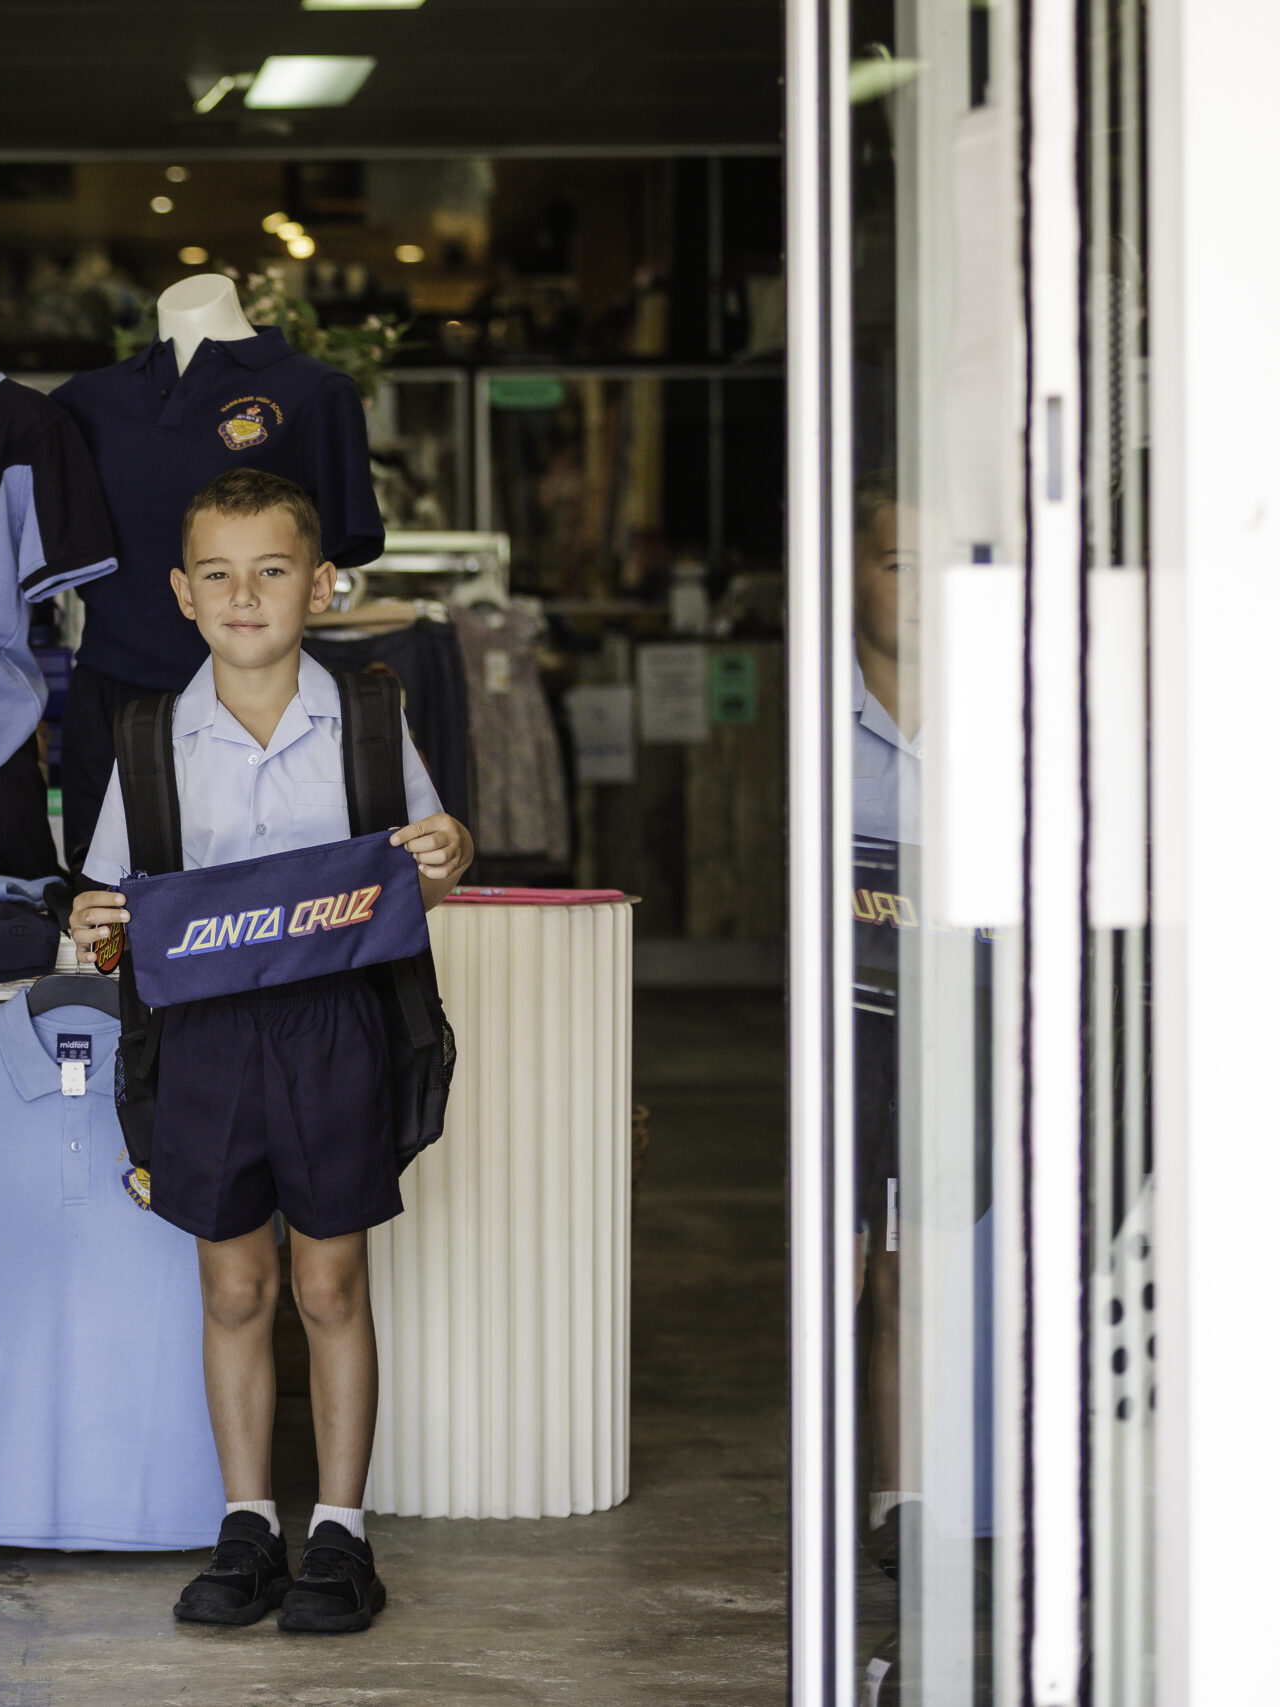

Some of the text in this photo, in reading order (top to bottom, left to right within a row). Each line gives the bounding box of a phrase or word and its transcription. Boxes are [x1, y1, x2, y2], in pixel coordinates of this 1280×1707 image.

[166, 884, 382, 960] SANTA CRUZ
[98, 936, 120, 967] CRUZ
[60, 1041, 89, 1049] midford
